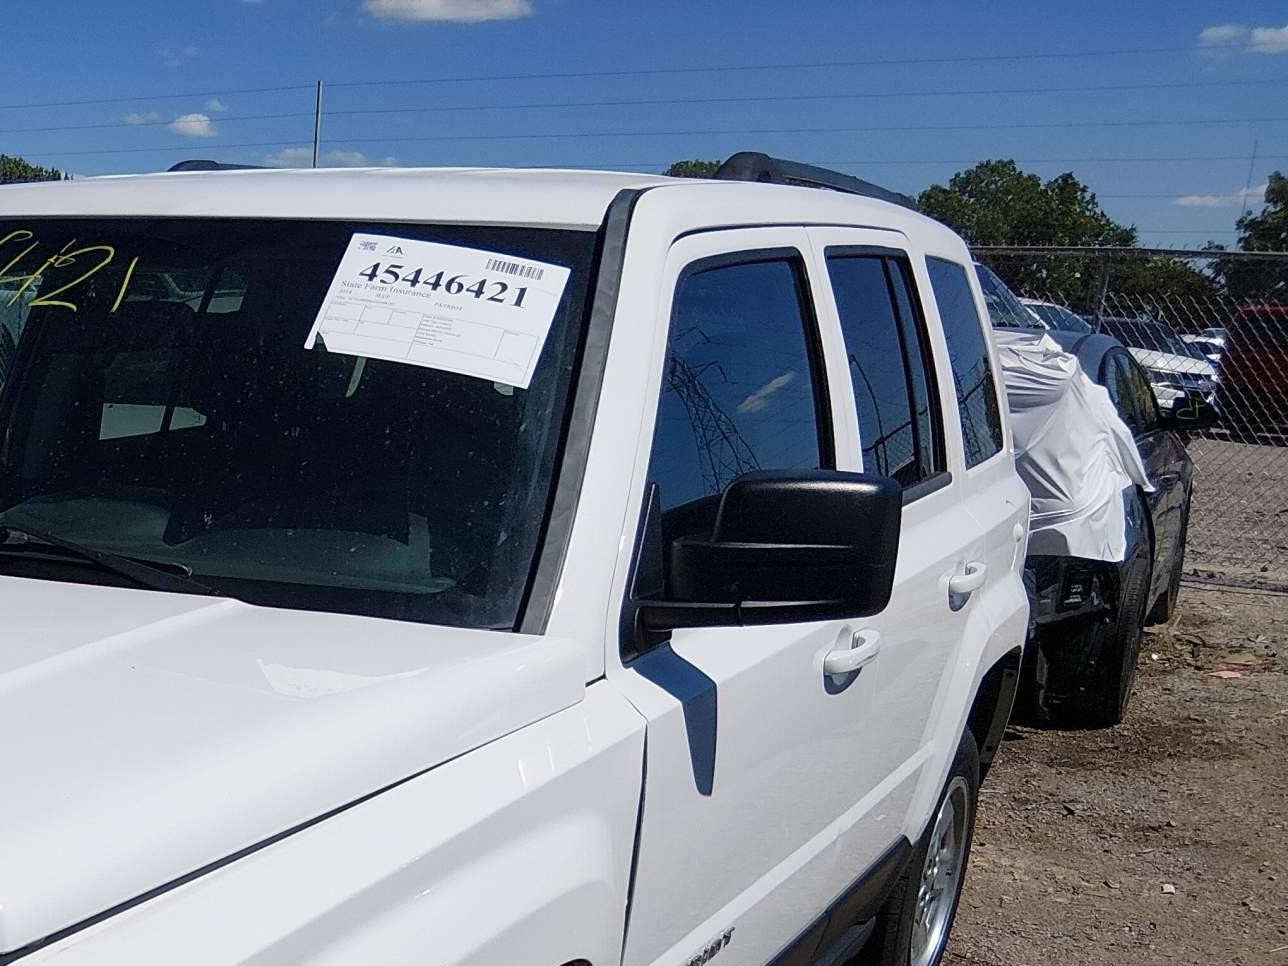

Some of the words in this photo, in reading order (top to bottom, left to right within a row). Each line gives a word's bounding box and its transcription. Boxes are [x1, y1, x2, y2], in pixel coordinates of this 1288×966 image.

[340, 280, 363, 290] State
[364, 283, 388, 293] Farm
[389, 286, 432, 299] Insurance
[359, 262, 529, 308] 45446421
